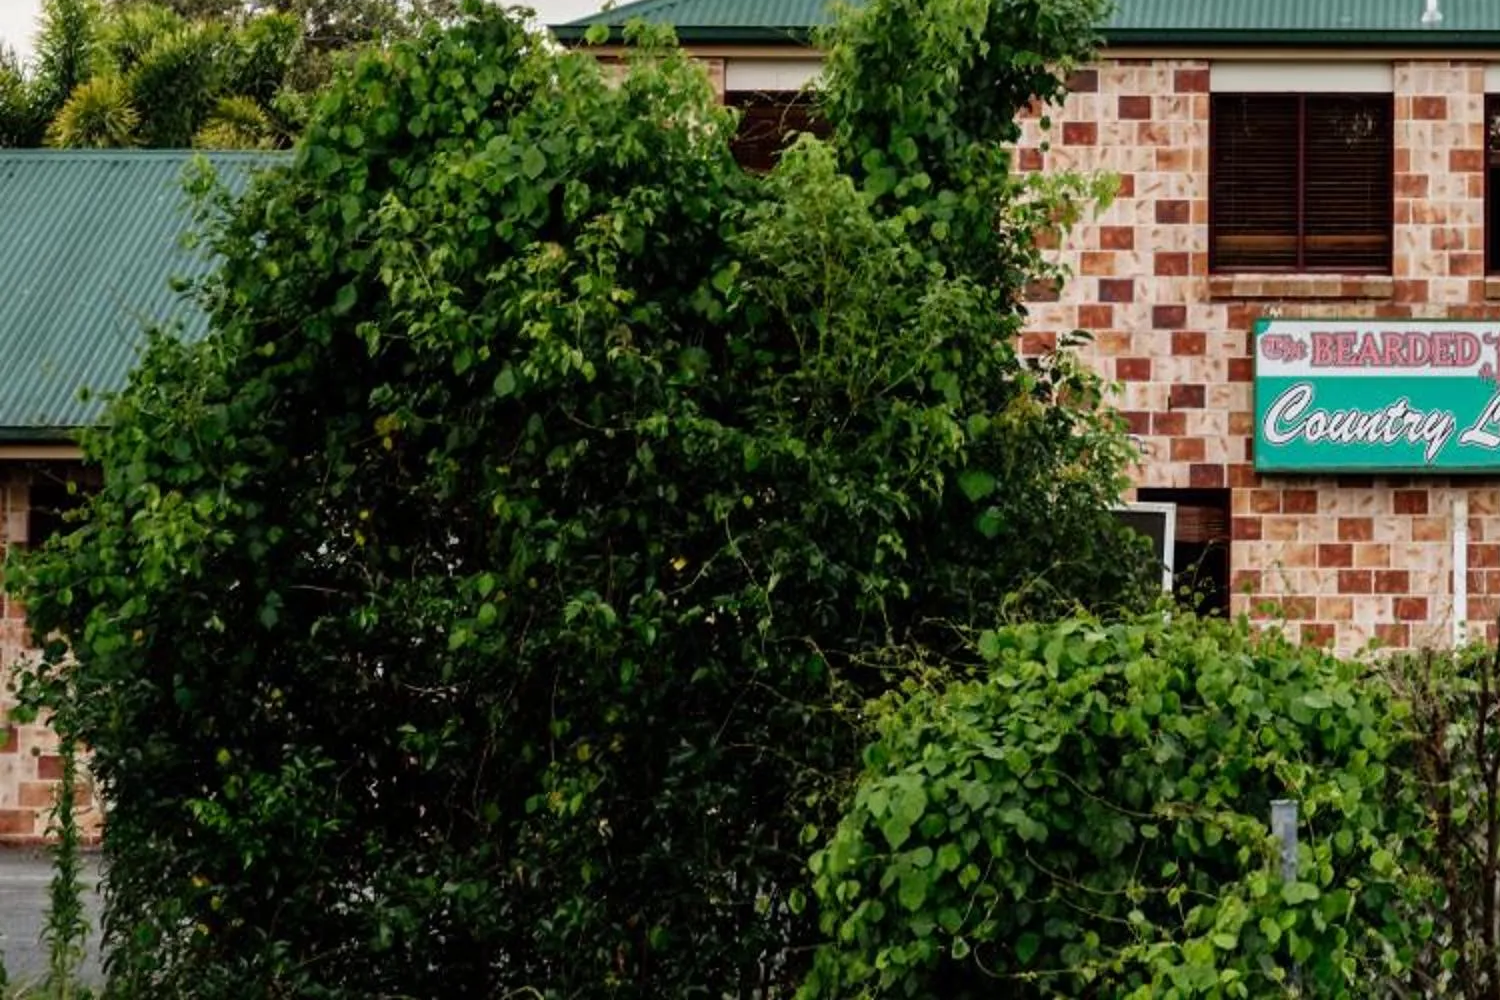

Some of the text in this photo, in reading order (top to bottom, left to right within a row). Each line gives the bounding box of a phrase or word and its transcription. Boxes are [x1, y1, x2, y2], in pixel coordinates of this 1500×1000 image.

[1261, 333, 1309, 362] The
[1310, 331, 1480, 367] BEARDED
[1263, 381, 1457, 464] Country
